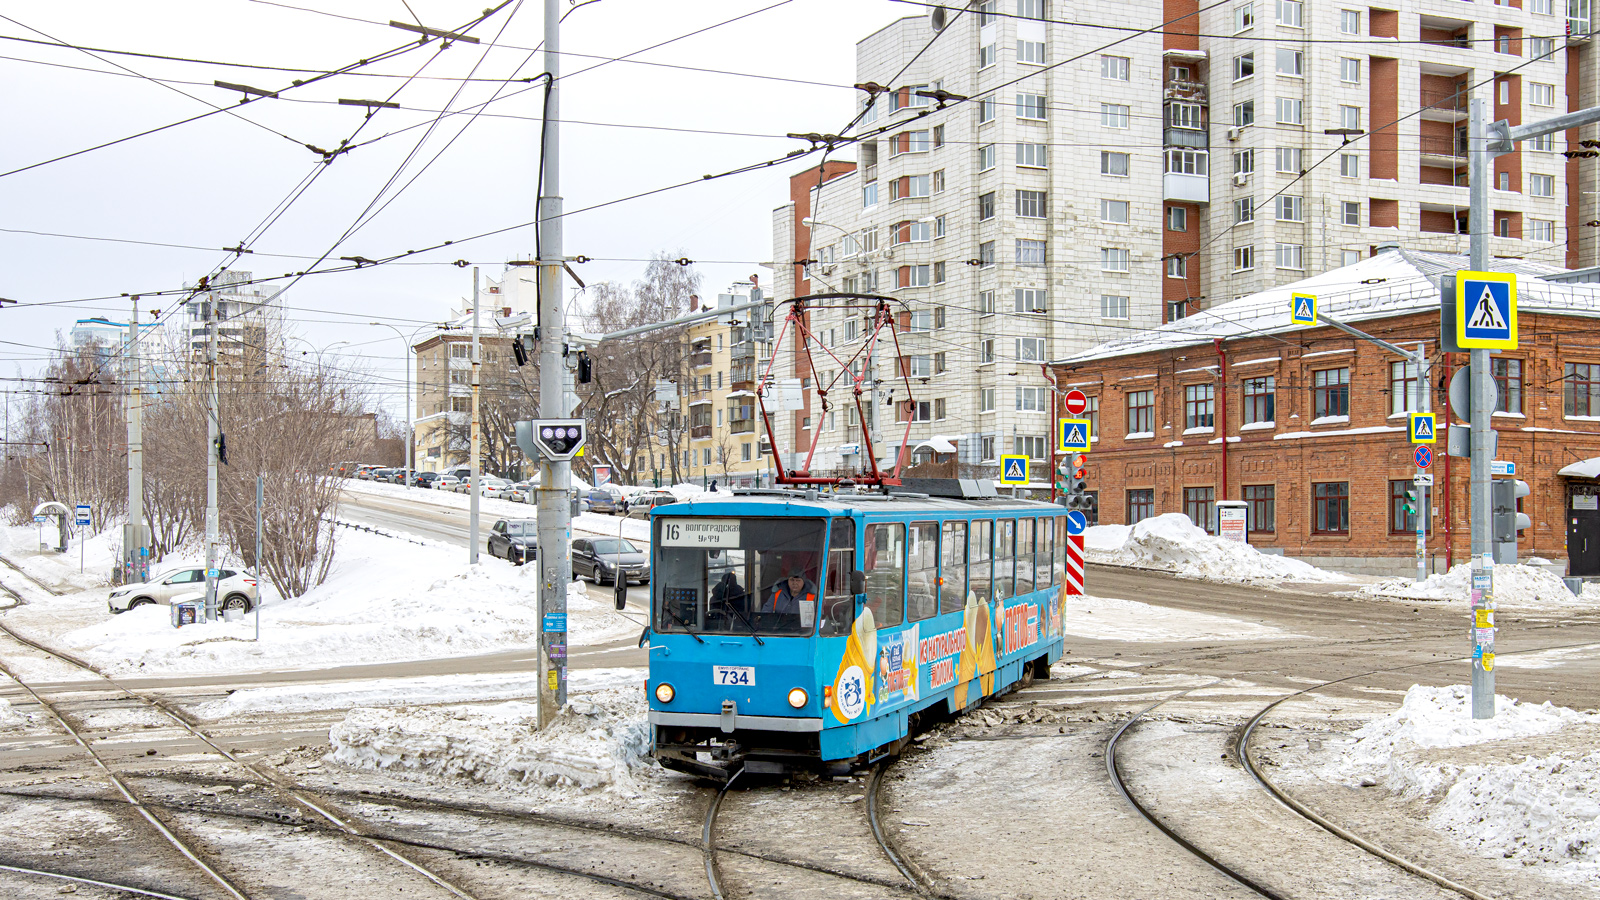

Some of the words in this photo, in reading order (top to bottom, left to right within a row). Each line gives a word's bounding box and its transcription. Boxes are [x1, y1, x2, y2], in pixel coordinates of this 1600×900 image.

[666, 524, 680, 540] 16
[920, 638, 928, 666] ИЗ
[928, 626, 966, 663] НАТУРАЛЬНОГО
[720, 671, 749, 684] 734
[930, 657, 954, 690] МОЛОКА
